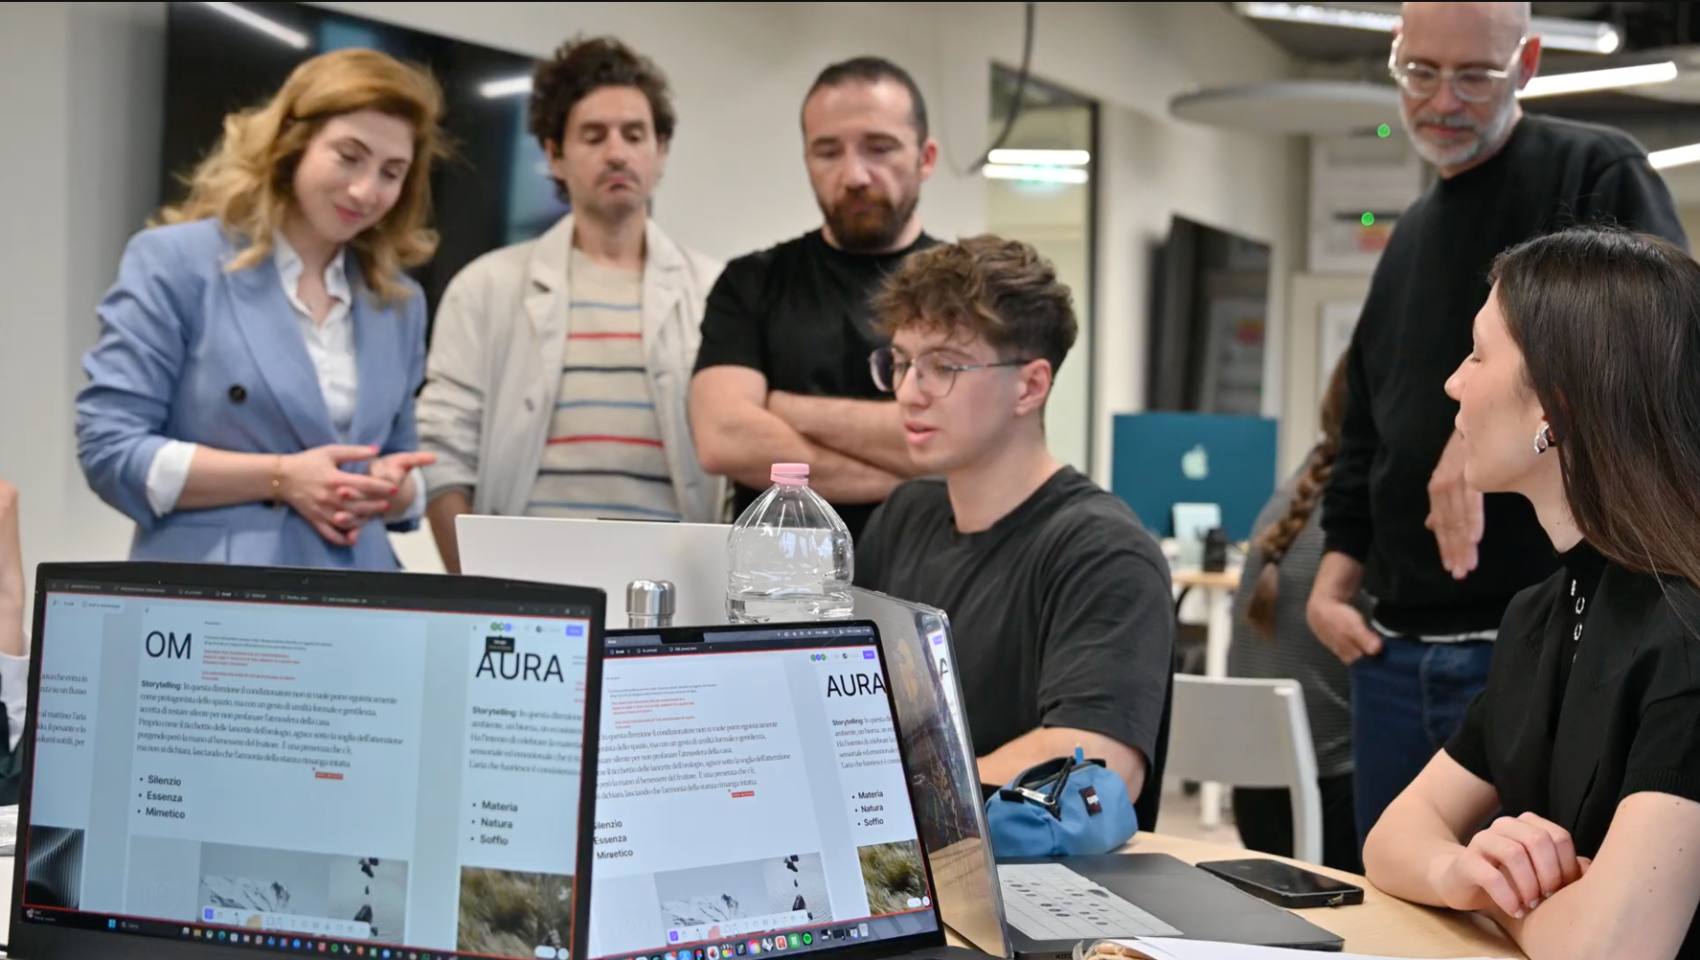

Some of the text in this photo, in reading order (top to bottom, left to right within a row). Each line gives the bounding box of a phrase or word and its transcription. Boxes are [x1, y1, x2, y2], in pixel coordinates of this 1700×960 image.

[146, 630, 192, 660] OM
[476, 651, 564, 682] AURA
[826, 672, 886, 698] AURA
[148, 774, 182, 787] Silenzio
[146, 791, 183, 803] Essenza
[858, 790, 884, 799] Materia
[482, 800, 518, 812] Materia
[861, 804, 884, 813] Natura
[146, 808, 186, 820] Mimetico
[480, 818, 513, 828] Natura
[864, 818, 884, 826] Soffio
[480, 834, 509, 846] Soffio
